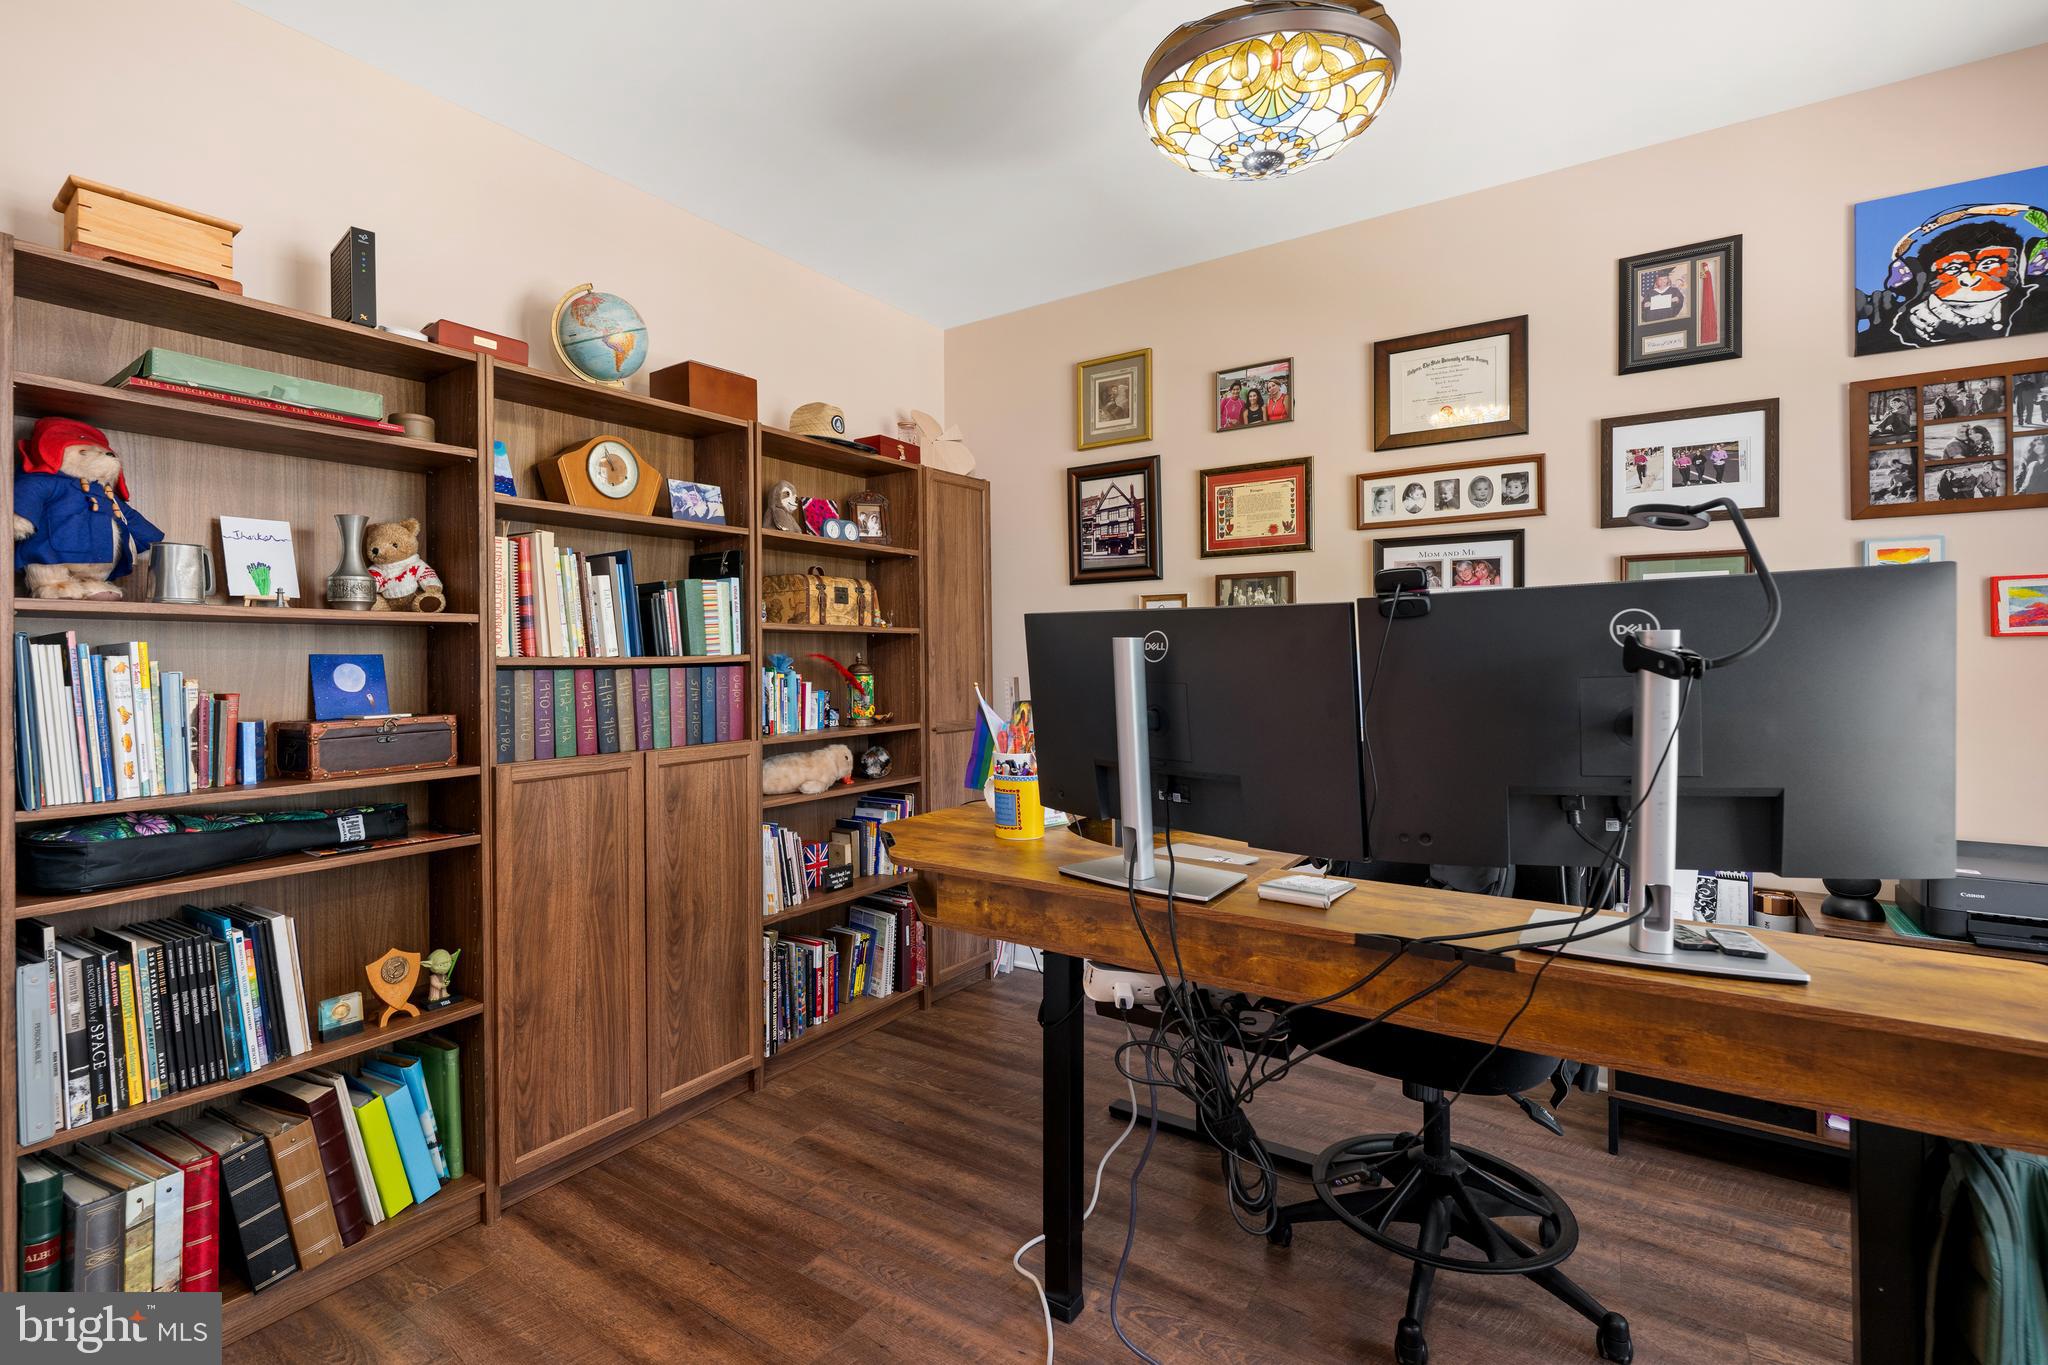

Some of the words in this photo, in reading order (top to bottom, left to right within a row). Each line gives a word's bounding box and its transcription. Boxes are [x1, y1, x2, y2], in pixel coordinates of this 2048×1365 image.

[1441, 356, 1461, 364] University
[137, 379, 161, 389] THE
[165, 384, 227, 399] TIMECHART
[229, 395, 273, 408] HISTORY
[275, 403, 289, 412] OF
[292, 407, 310, 416] THE
[312, 410, 344, 421] WORLD
[1145, 642, 1166, 651] DELL
[1960, 891, 1986, 899] Canon
[87, 964, 96, 1014] ENCYCLOPEDIA
[119, 970, 133, 1018] ASTRONOMY
[150, 969, 159, 999] STARRY
[153, 1001, 162, 1030] NIGHTS
[90, 1024, 107, 1070] SPACE
[158, 1052, 167, 1080] RAYMO
